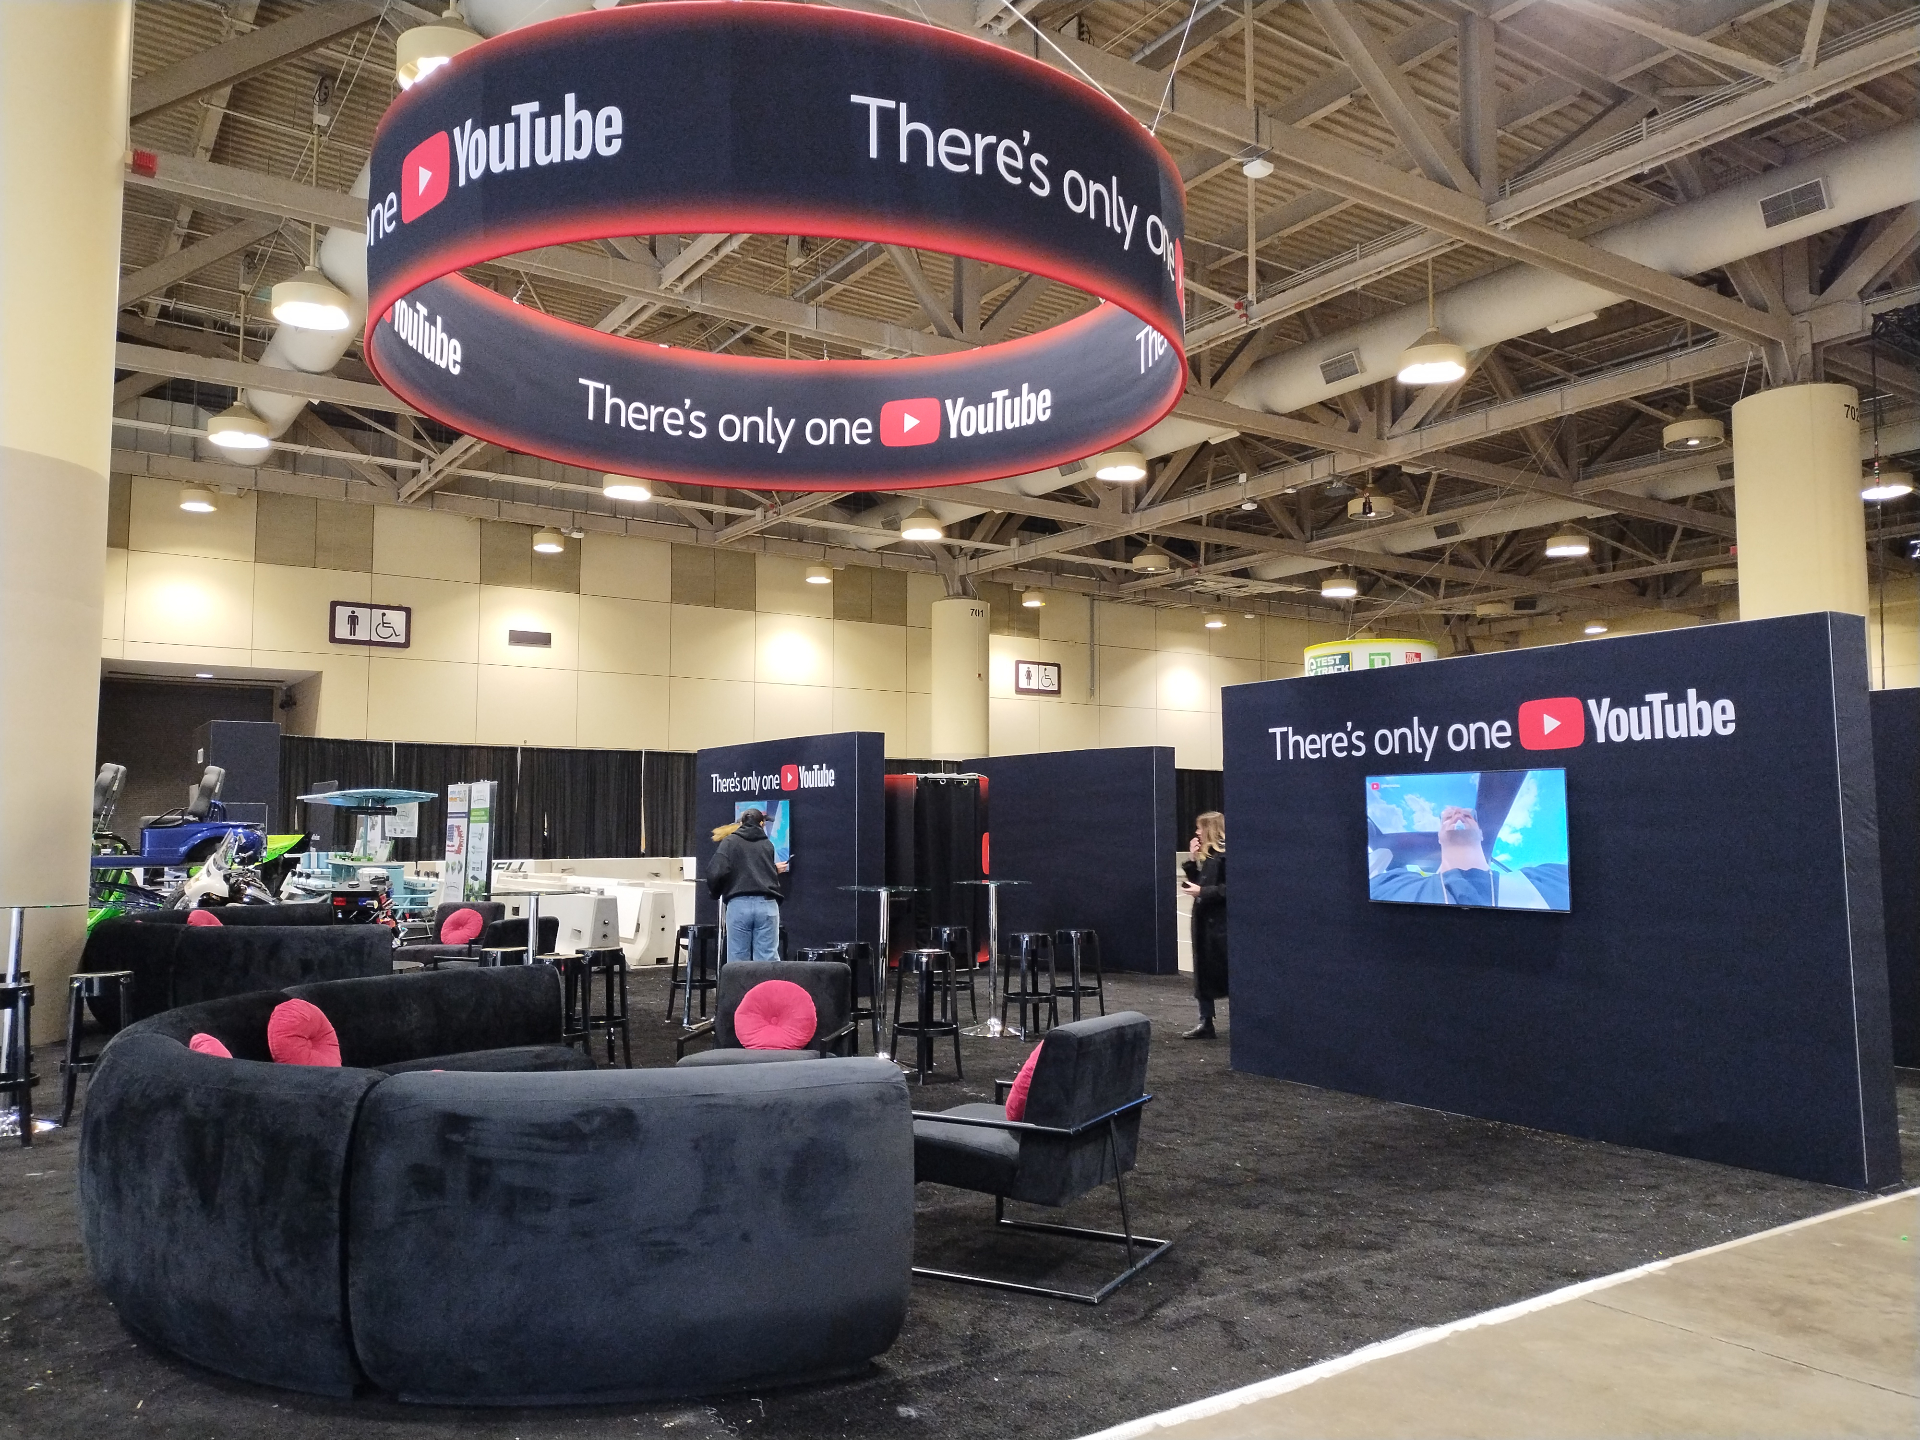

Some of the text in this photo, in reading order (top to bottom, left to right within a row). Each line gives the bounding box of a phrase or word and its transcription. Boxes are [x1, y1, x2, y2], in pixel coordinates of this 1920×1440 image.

[453, 93, 622, 187] YouTube
[851, 95, 1174, 281] There's only one
[395, 299, 461, 374] YouTube
[1136, 325, 1167, 374] The
[579, 378, 1051, 453] There's only one YouTube
[970, 608, 984, 618] 701
[1316, 655, 1341, 666] TEST
[1269, 689, 1735, 761] There's only one YouTube
[711, 764, 834, 795] There's only one YouTube
